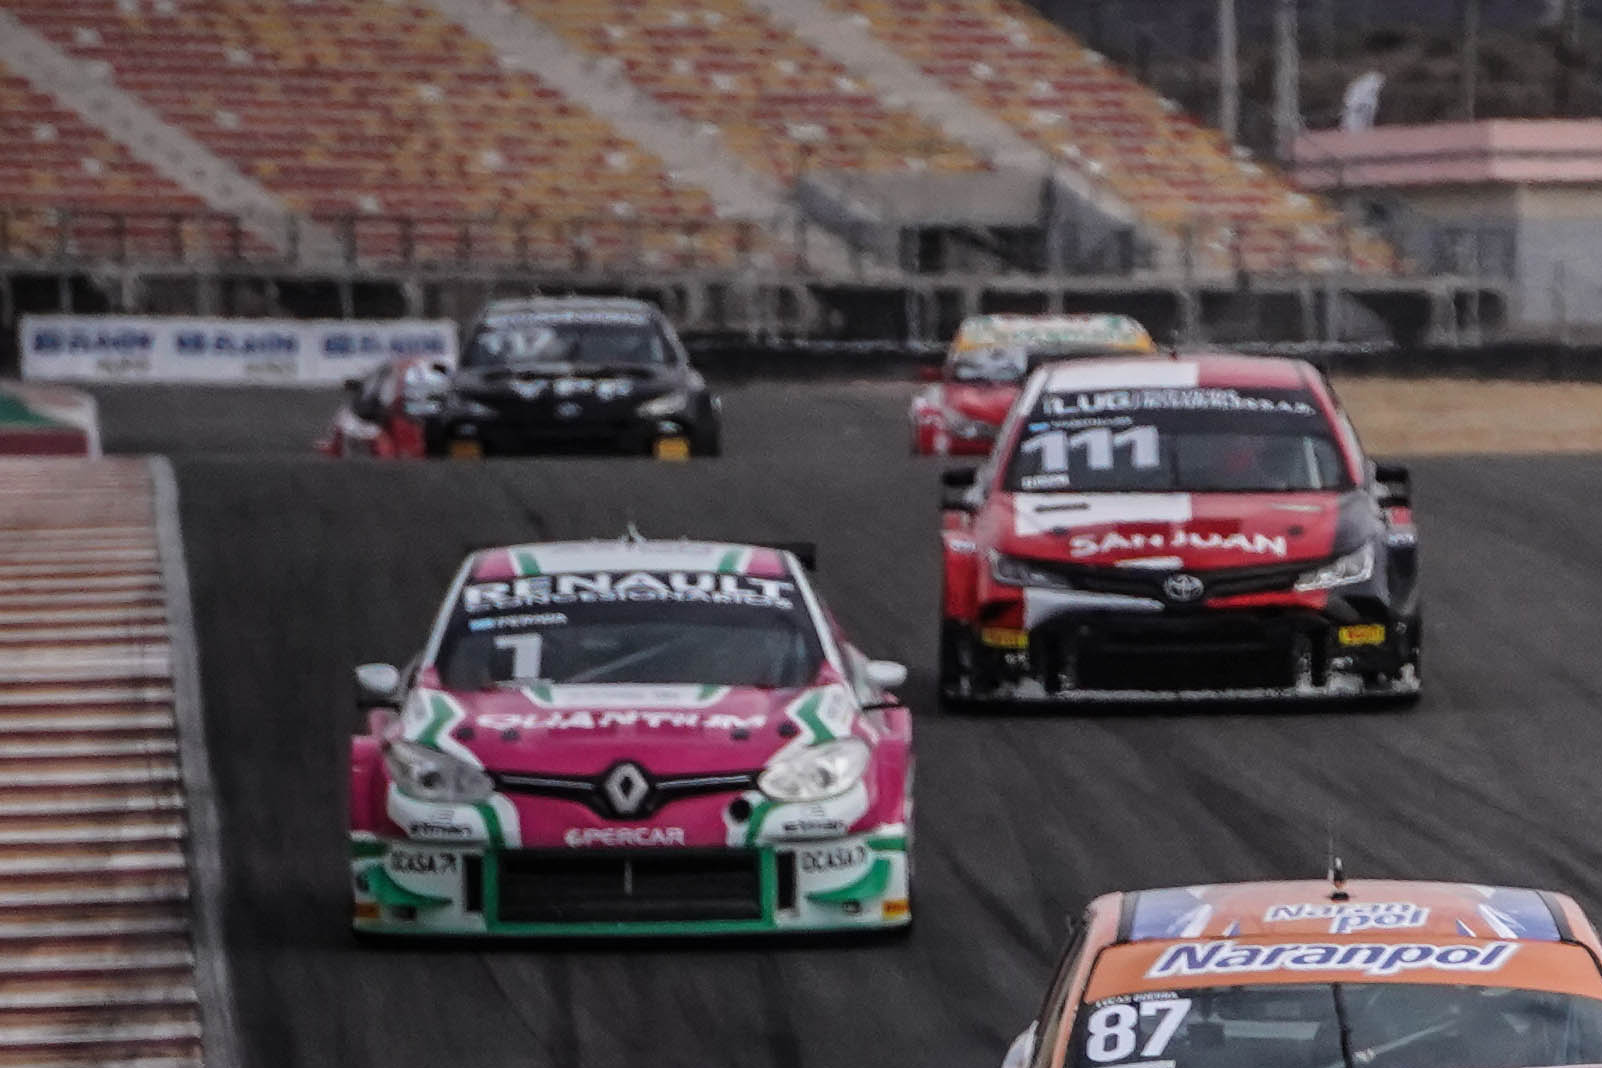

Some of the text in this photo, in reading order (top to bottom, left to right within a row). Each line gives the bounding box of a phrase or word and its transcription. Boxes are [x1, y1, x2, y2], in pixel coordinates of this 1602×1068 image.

[1020, 425, 1160, 474] 111
[464, 572, 796, 611] RENAULT
[494, 633, 543, 680] 1
[1145, 941, 1522, 977] Naranpol
[1086, 998, 1192, 1062] 87
